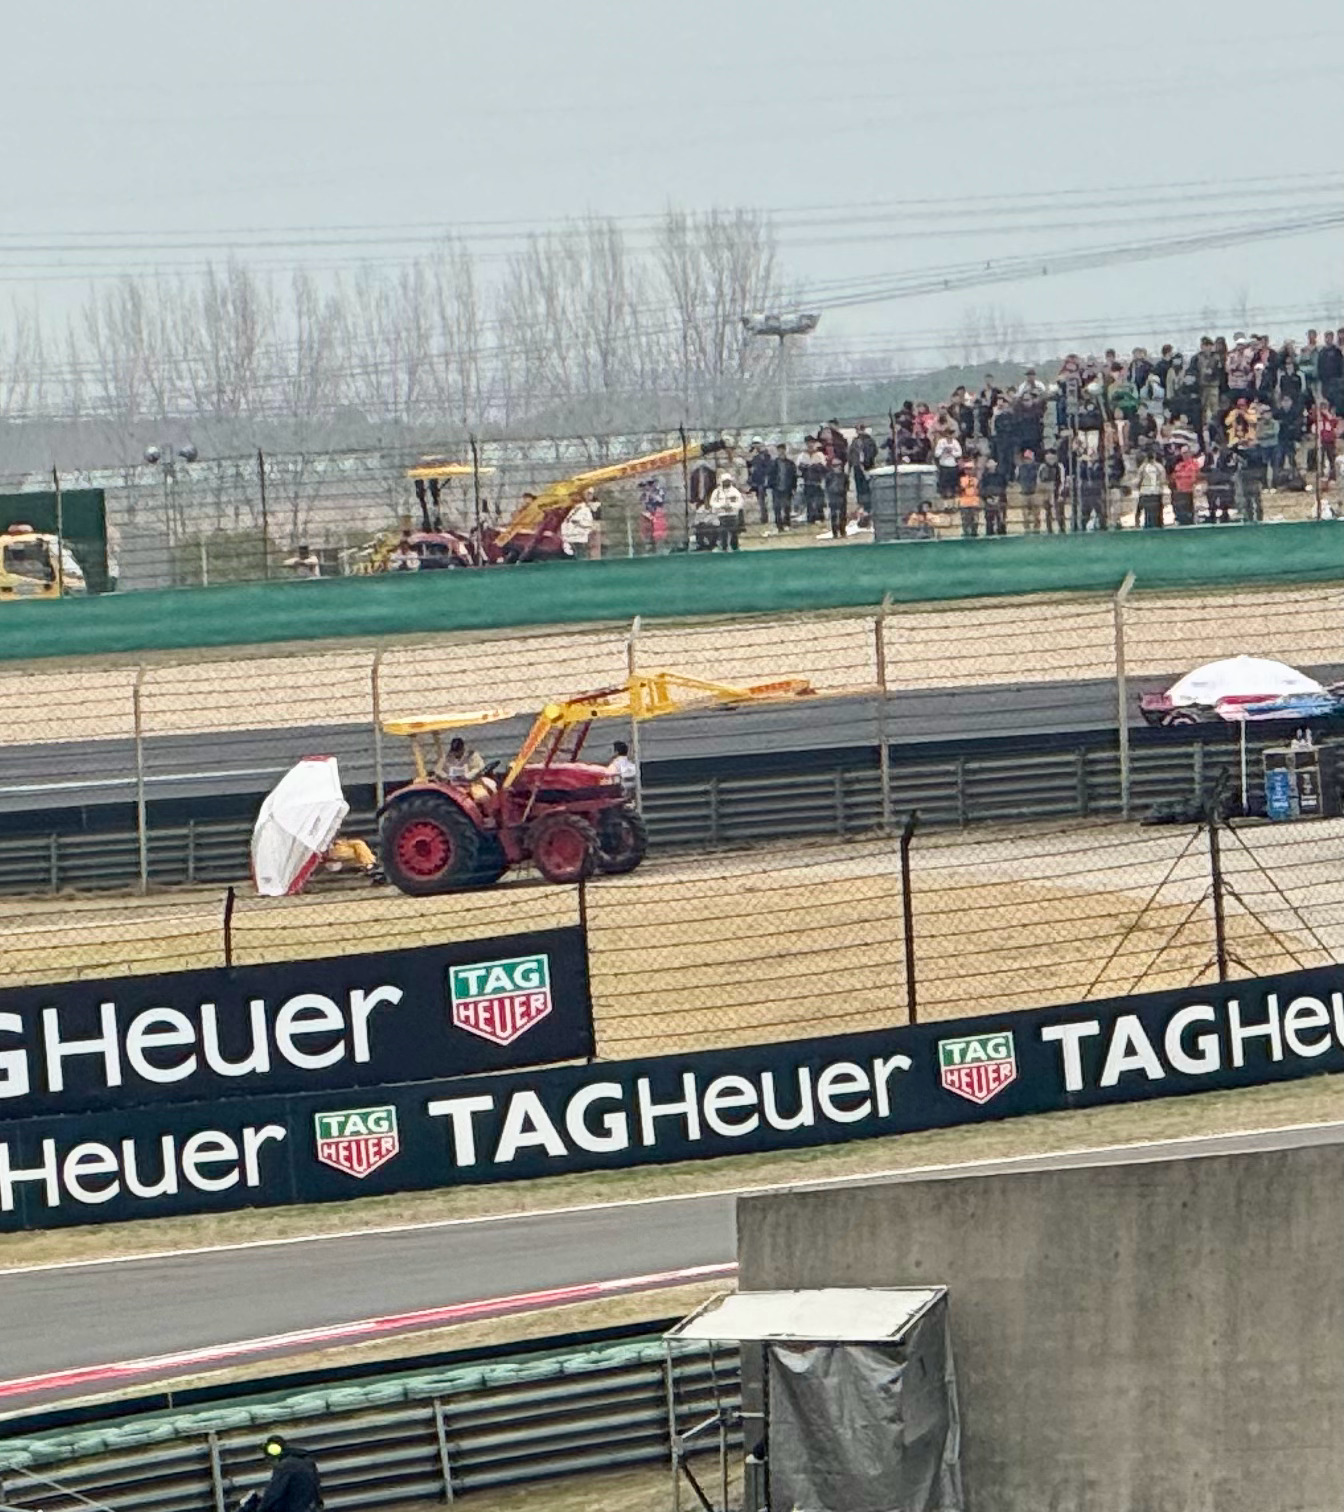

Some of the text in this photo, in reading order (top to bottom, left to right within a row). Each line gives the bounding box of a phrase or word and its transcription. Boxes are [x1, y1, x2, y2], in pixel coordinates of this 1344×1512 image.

[457, 960, 540, 995] TAG
[456, 991, 548, 1037] HEUER
[944, 1037, 1008, 1061] TAG
[1042, 990, 1344, 1092] TAGHe
[942, 1061, 1013, 1097] HEUER
[324, 1110, 389, 1136] TAG
[428, 1053, 912, 1167] TAGHeuer
[320, 1136, 396, 1172] HEUER
